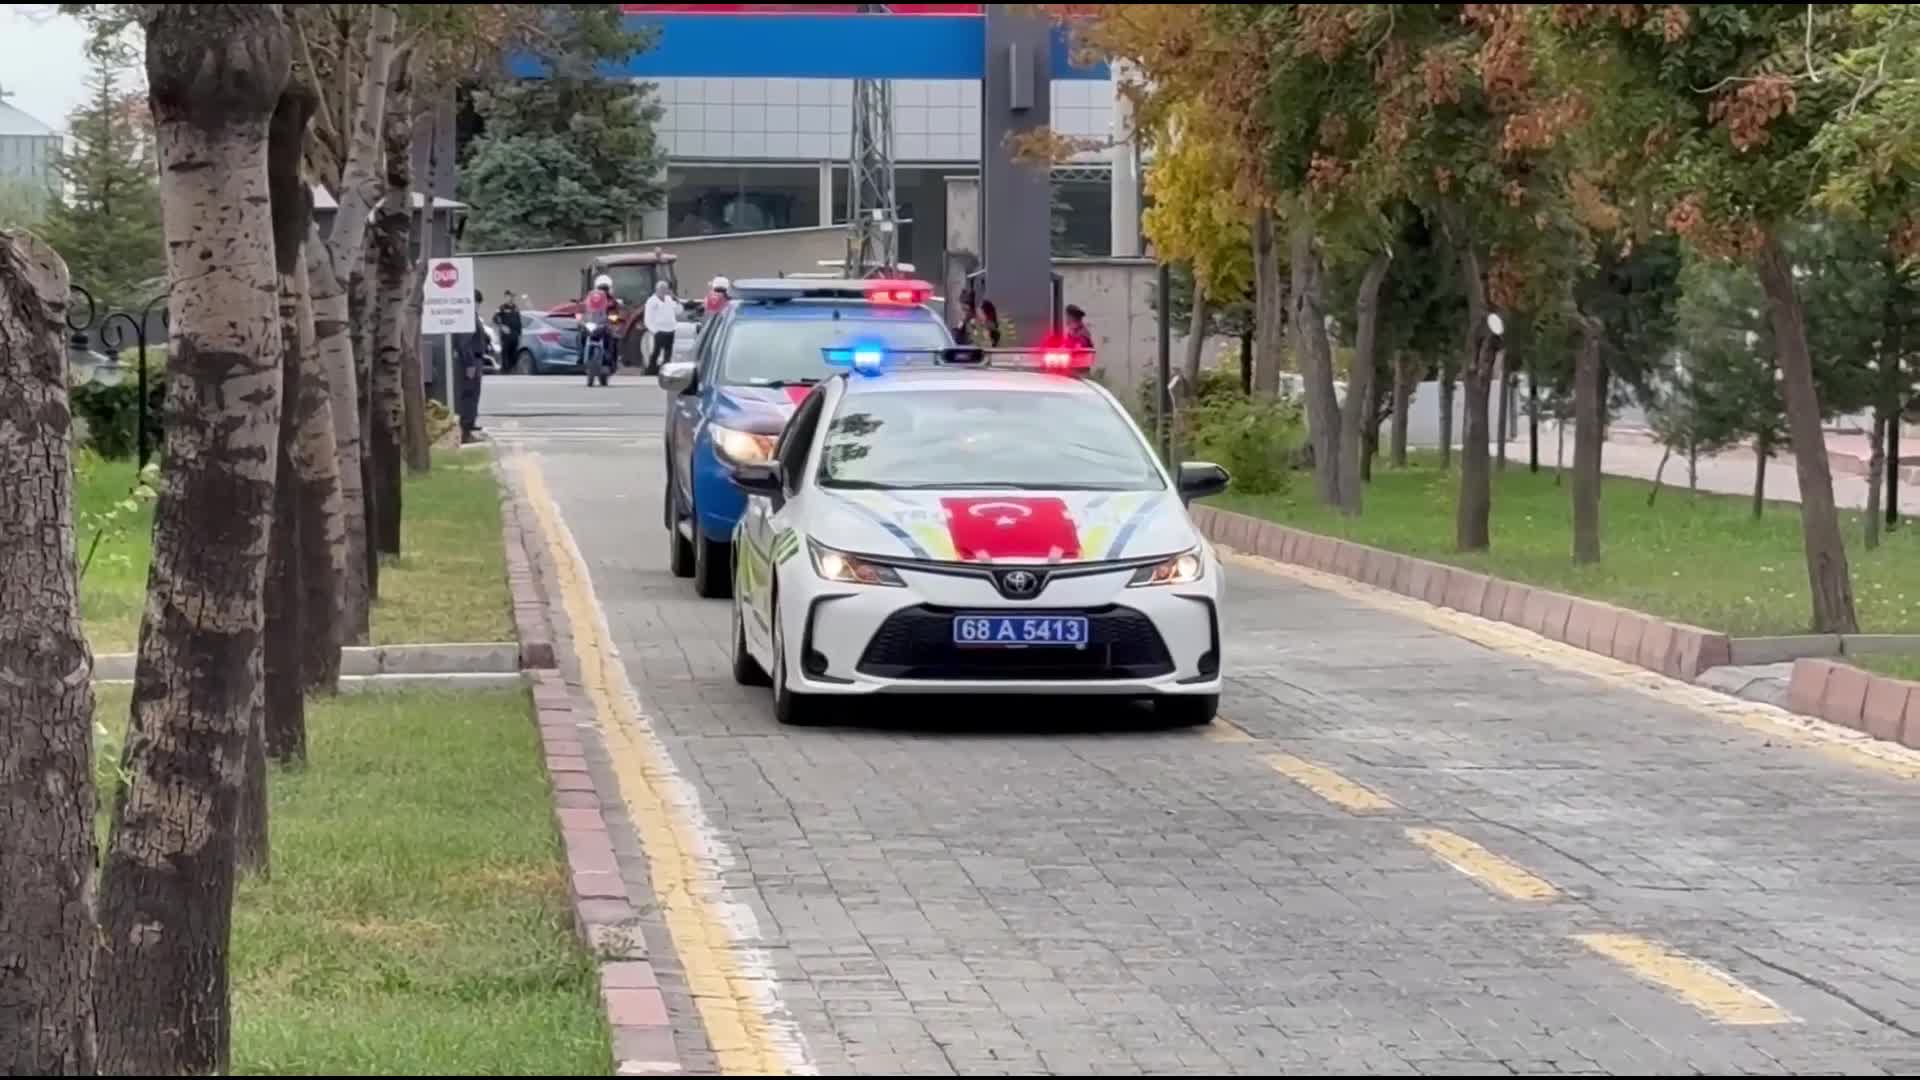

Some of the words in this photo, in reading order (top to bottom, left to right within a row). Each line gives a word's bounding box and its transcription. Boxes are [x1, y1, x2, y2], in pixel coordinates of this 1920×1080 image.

[962, 619, 990, 640] 68
[996, 619, 1016, 640] A
[1023, 620, 1080, 641] 5413
